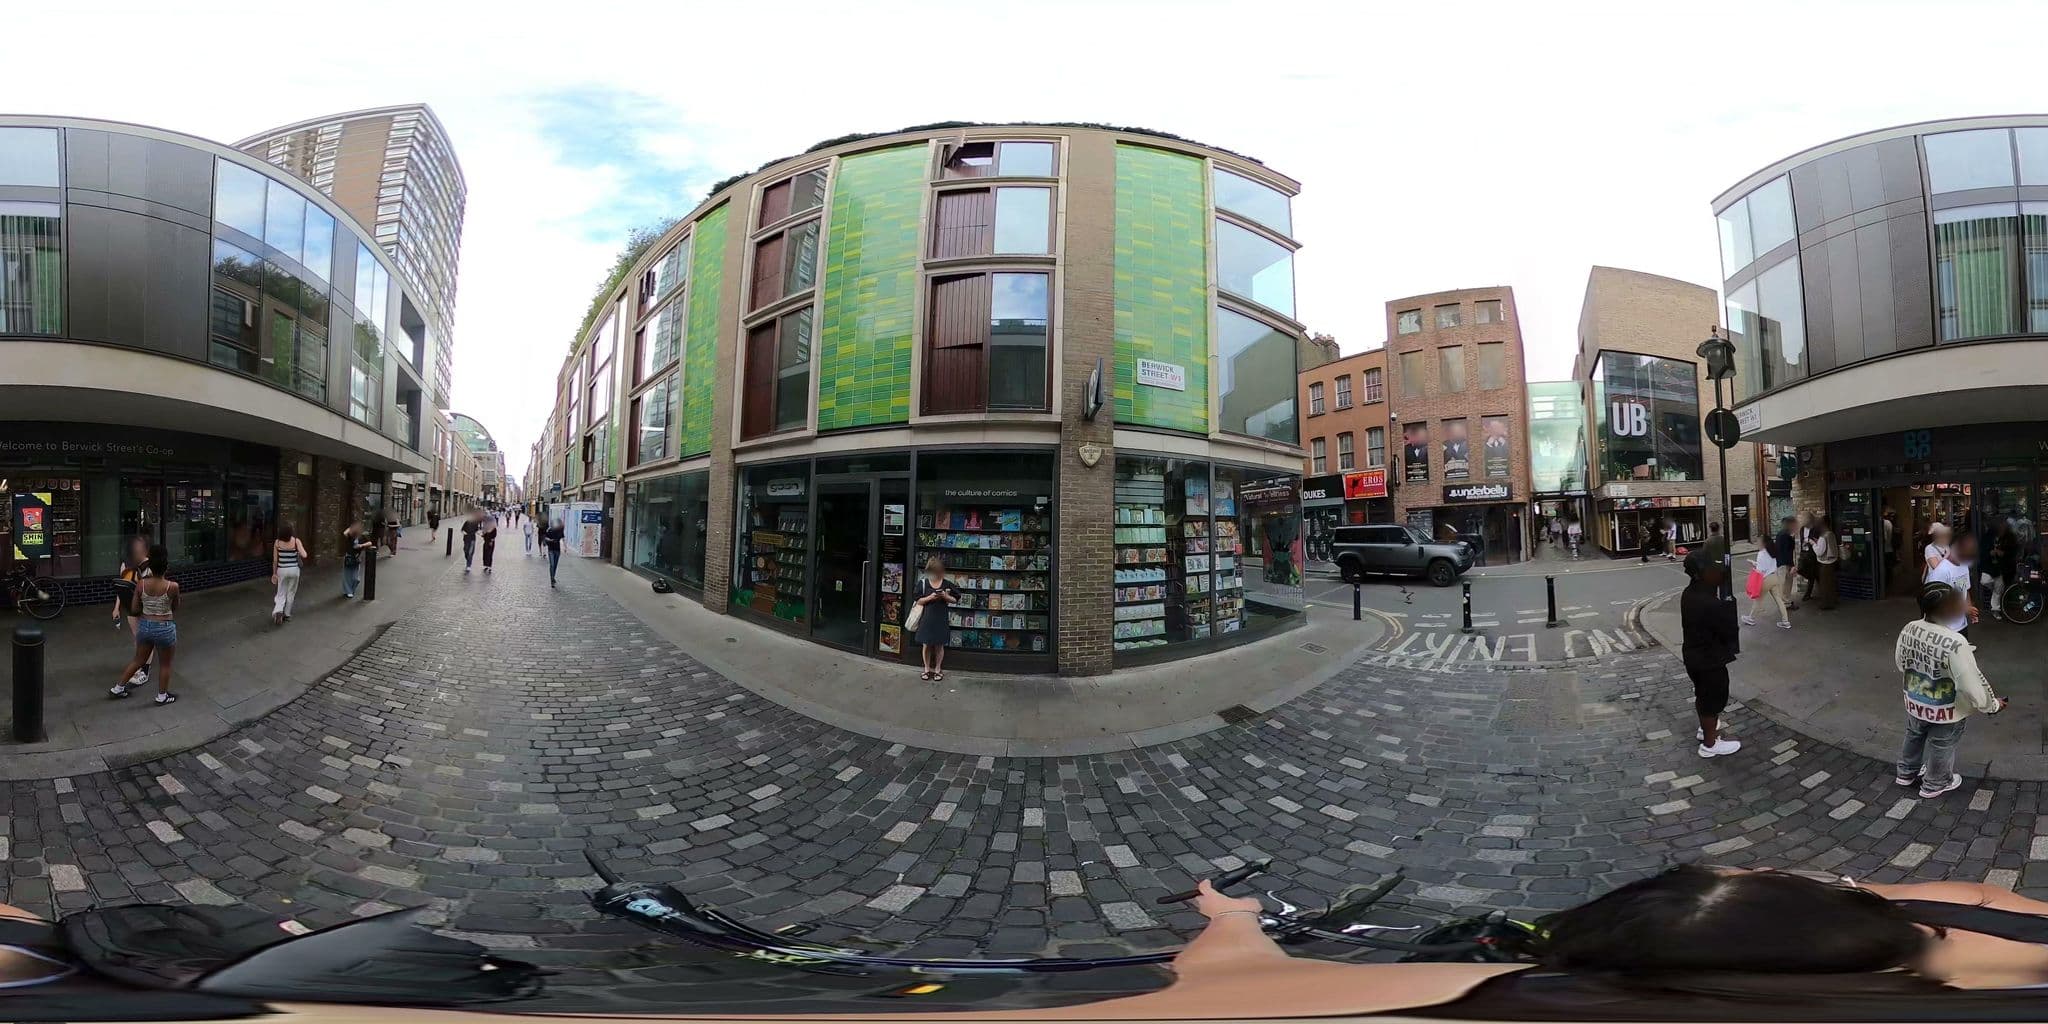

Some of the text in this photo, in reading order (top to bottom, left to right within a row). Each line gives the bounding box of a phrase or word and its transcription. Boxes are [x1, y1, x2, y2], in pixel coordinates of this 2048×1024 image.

[1142, 361, 1175, 374] BERWICK
[1141, 369, 1181, 382] STREET W1
[1612, 402, 1647, 436] UB
[0, 441, 174, 456] elcome to Berwick Street's Co-op
[1363, 476, 1383, 485] EROS
[1303, 489, 1326, 499] DUKES
[1457, 484, 1507, 496] underbelly
[1901, 633, 1950, 661] OURSELF
[1926, 632, 1962, 654] FUCK
